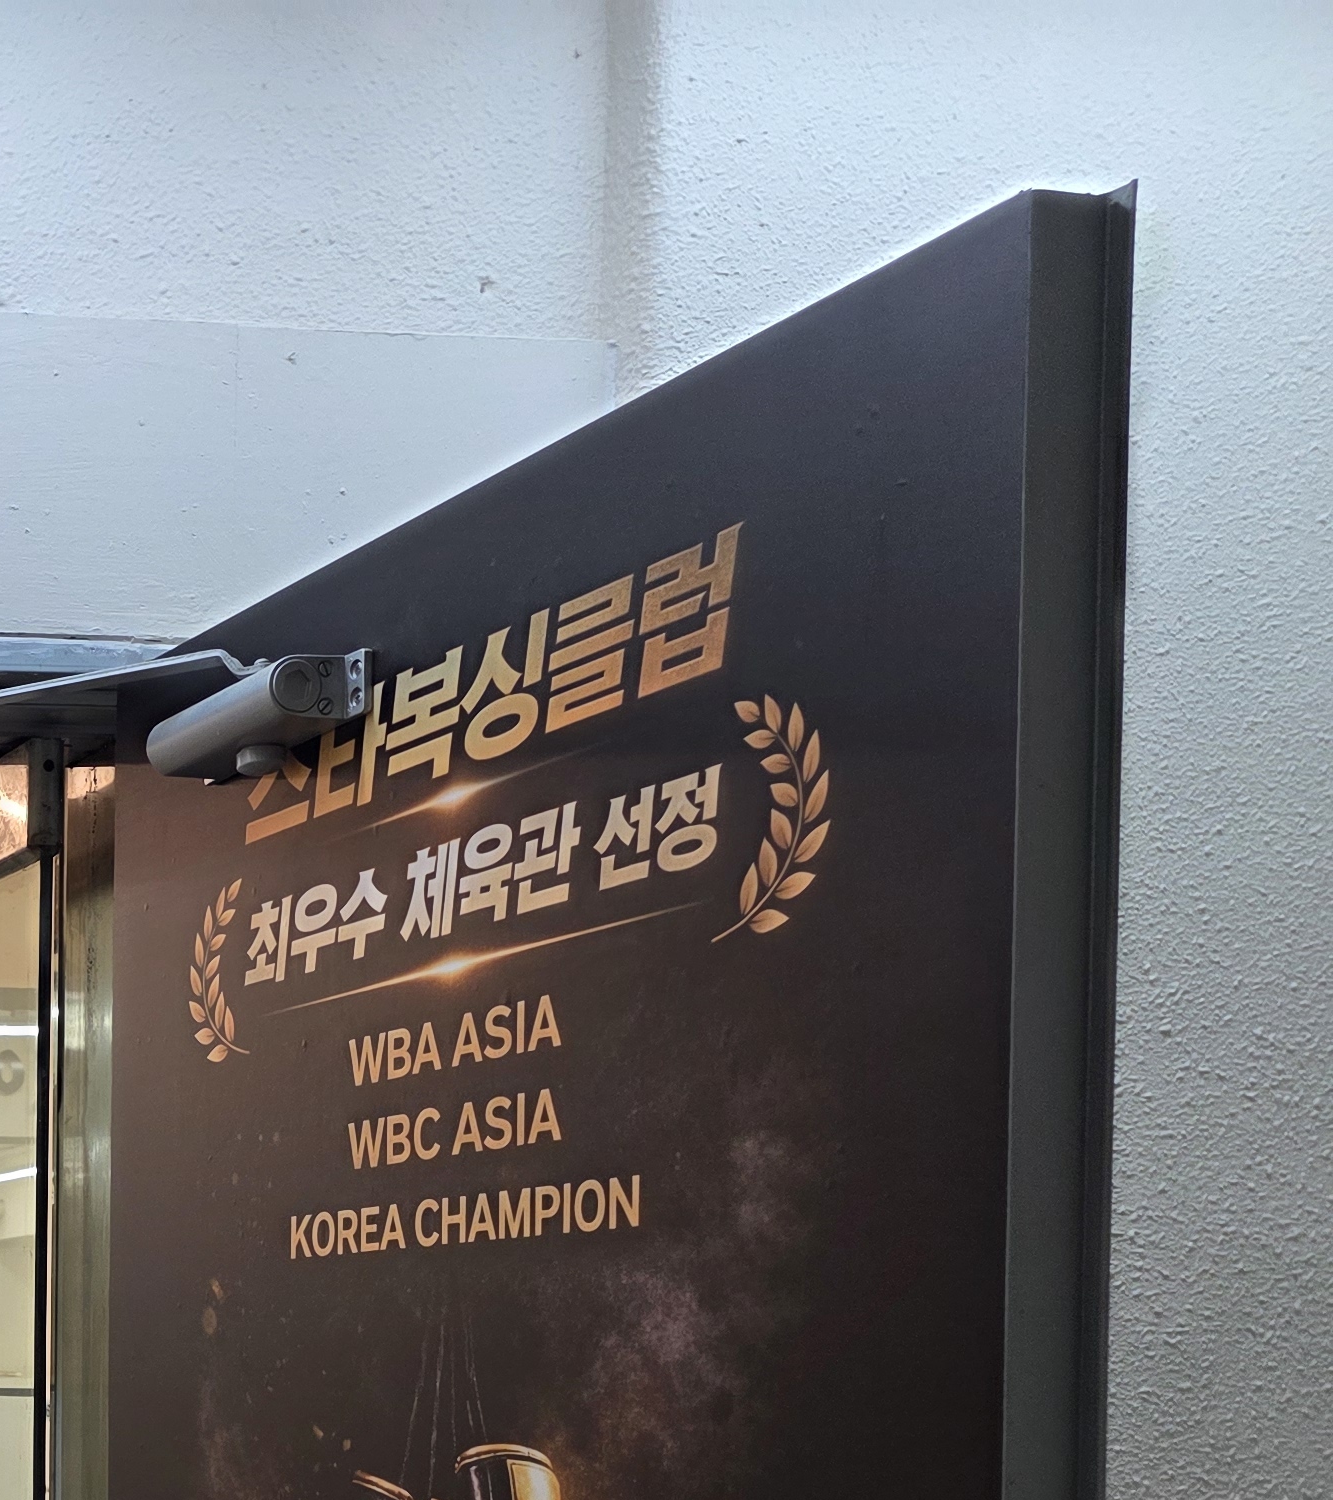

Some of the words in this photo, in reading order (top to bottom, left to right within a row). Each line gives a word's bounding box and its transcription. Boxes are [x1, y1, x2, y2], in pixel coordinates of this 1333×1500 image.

[243, 866, 390, 988] 최우수
[399, 801, 582, 944] 체육관
[593, 762, 724, 892] 선정
[348, 1021, 442, 1087] WBA
[452, 994, 563, 1069] ASIA
[348, 1107, 441, 1170] WBC
[452, 1088, 563, 1157] ASIA
[289, 1204, 407, 1260] KOREA
[413, 1174, 642, 1248] CHAMPION
